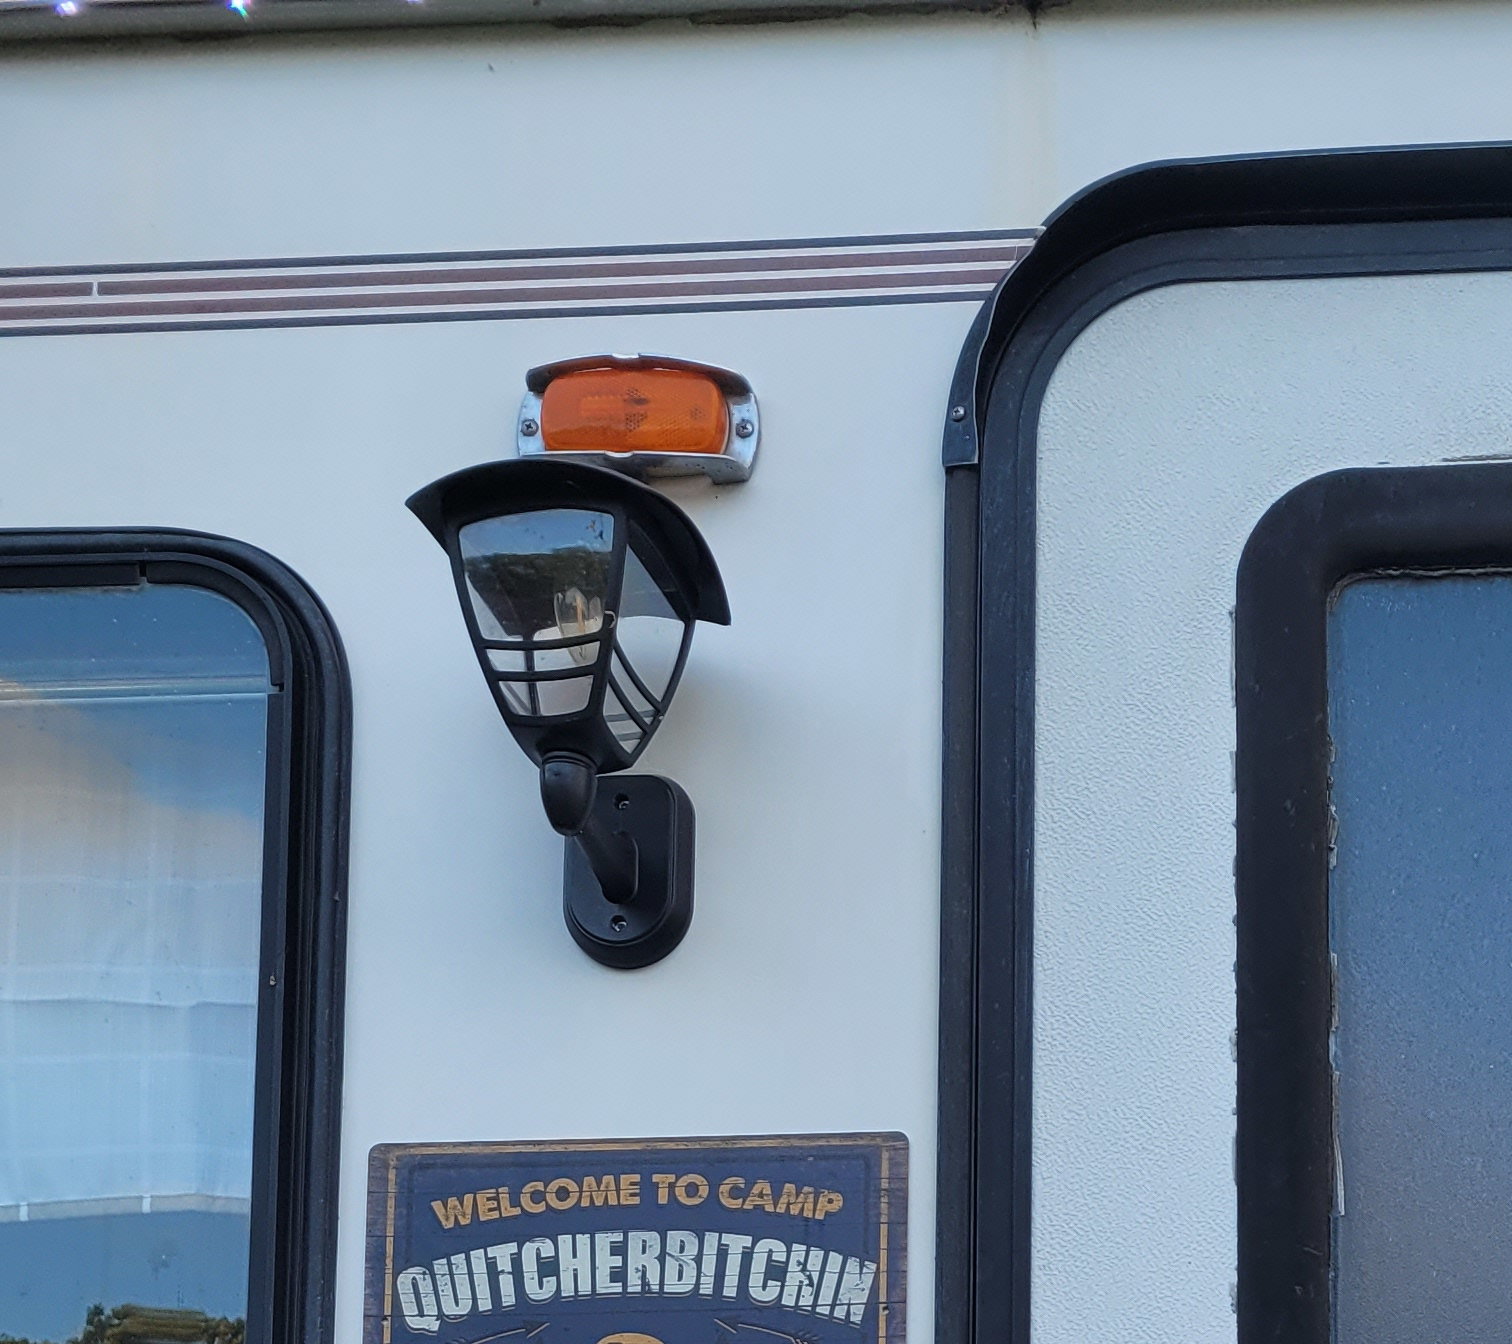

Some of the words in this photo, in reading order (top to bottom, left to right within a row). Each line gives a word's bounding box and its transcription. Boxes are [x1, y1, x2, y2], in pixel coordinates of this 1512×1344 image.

[430, 1173, 641, 1230] WELCOME
[652, 1173, 710, 1206] TO
[718, 1176, 844, 1220] CAMP
[396, 1230, 878, 1333] QUITCHERBITCHIN
